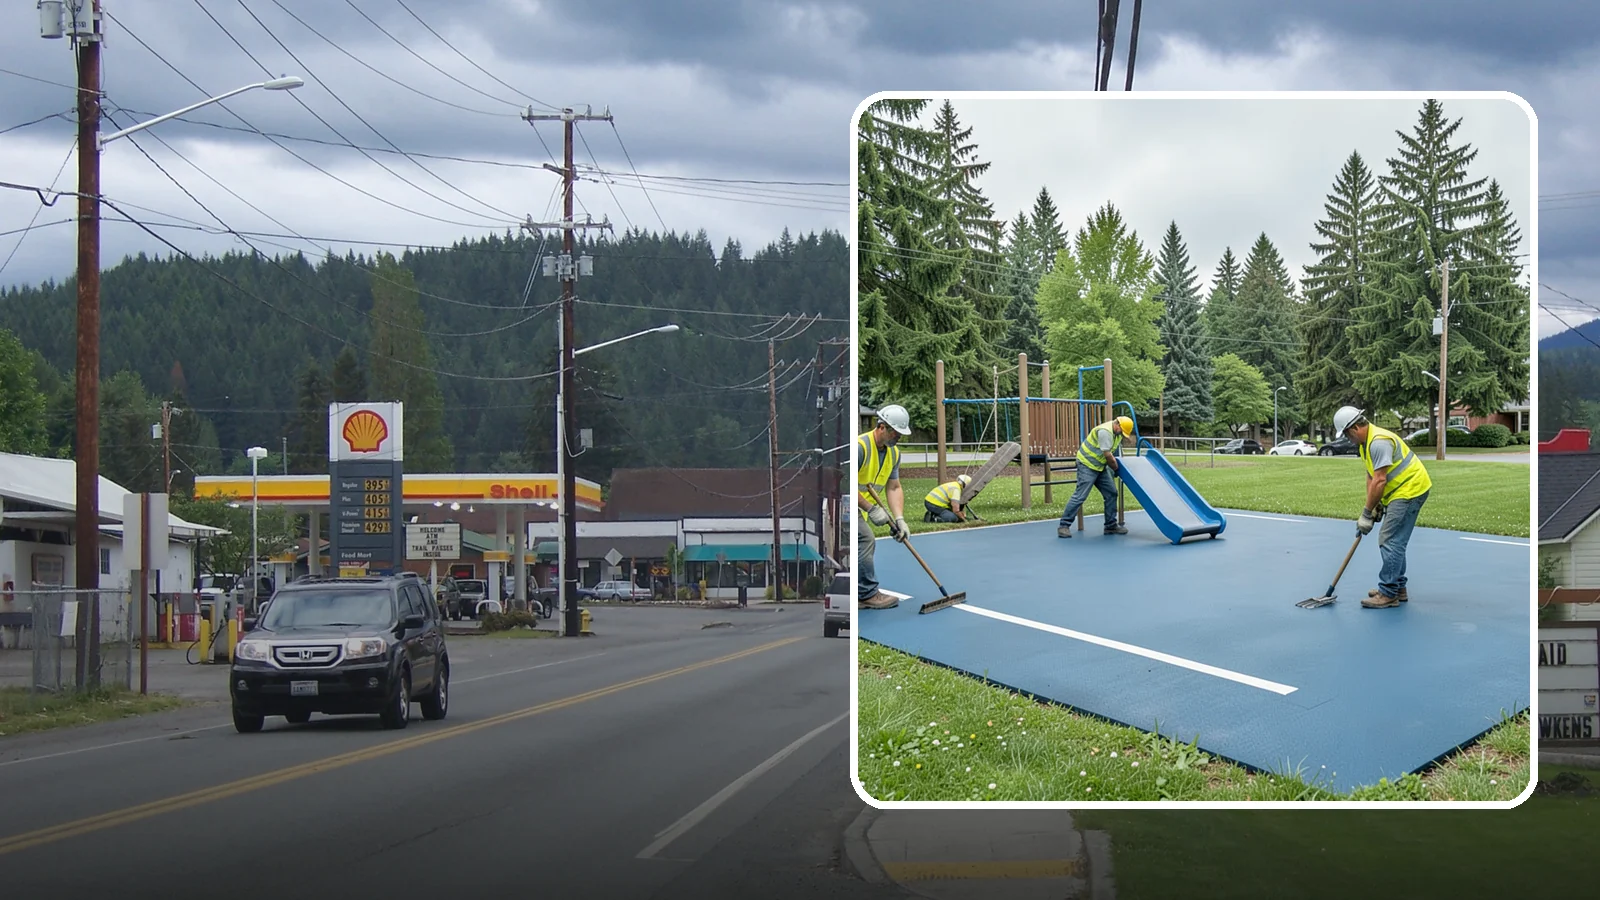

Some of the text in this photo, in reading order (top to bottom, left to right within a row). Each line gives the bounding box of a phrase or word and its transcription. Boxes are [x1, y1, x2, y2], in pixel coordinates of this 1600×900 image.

[365, 480, 384, 490] 395
[490, 484, 547, 499] Shell
[365, 494, 384, 504] 405
[365, 508, 383, 518] 415
[366, 522, 384, 532] 429
